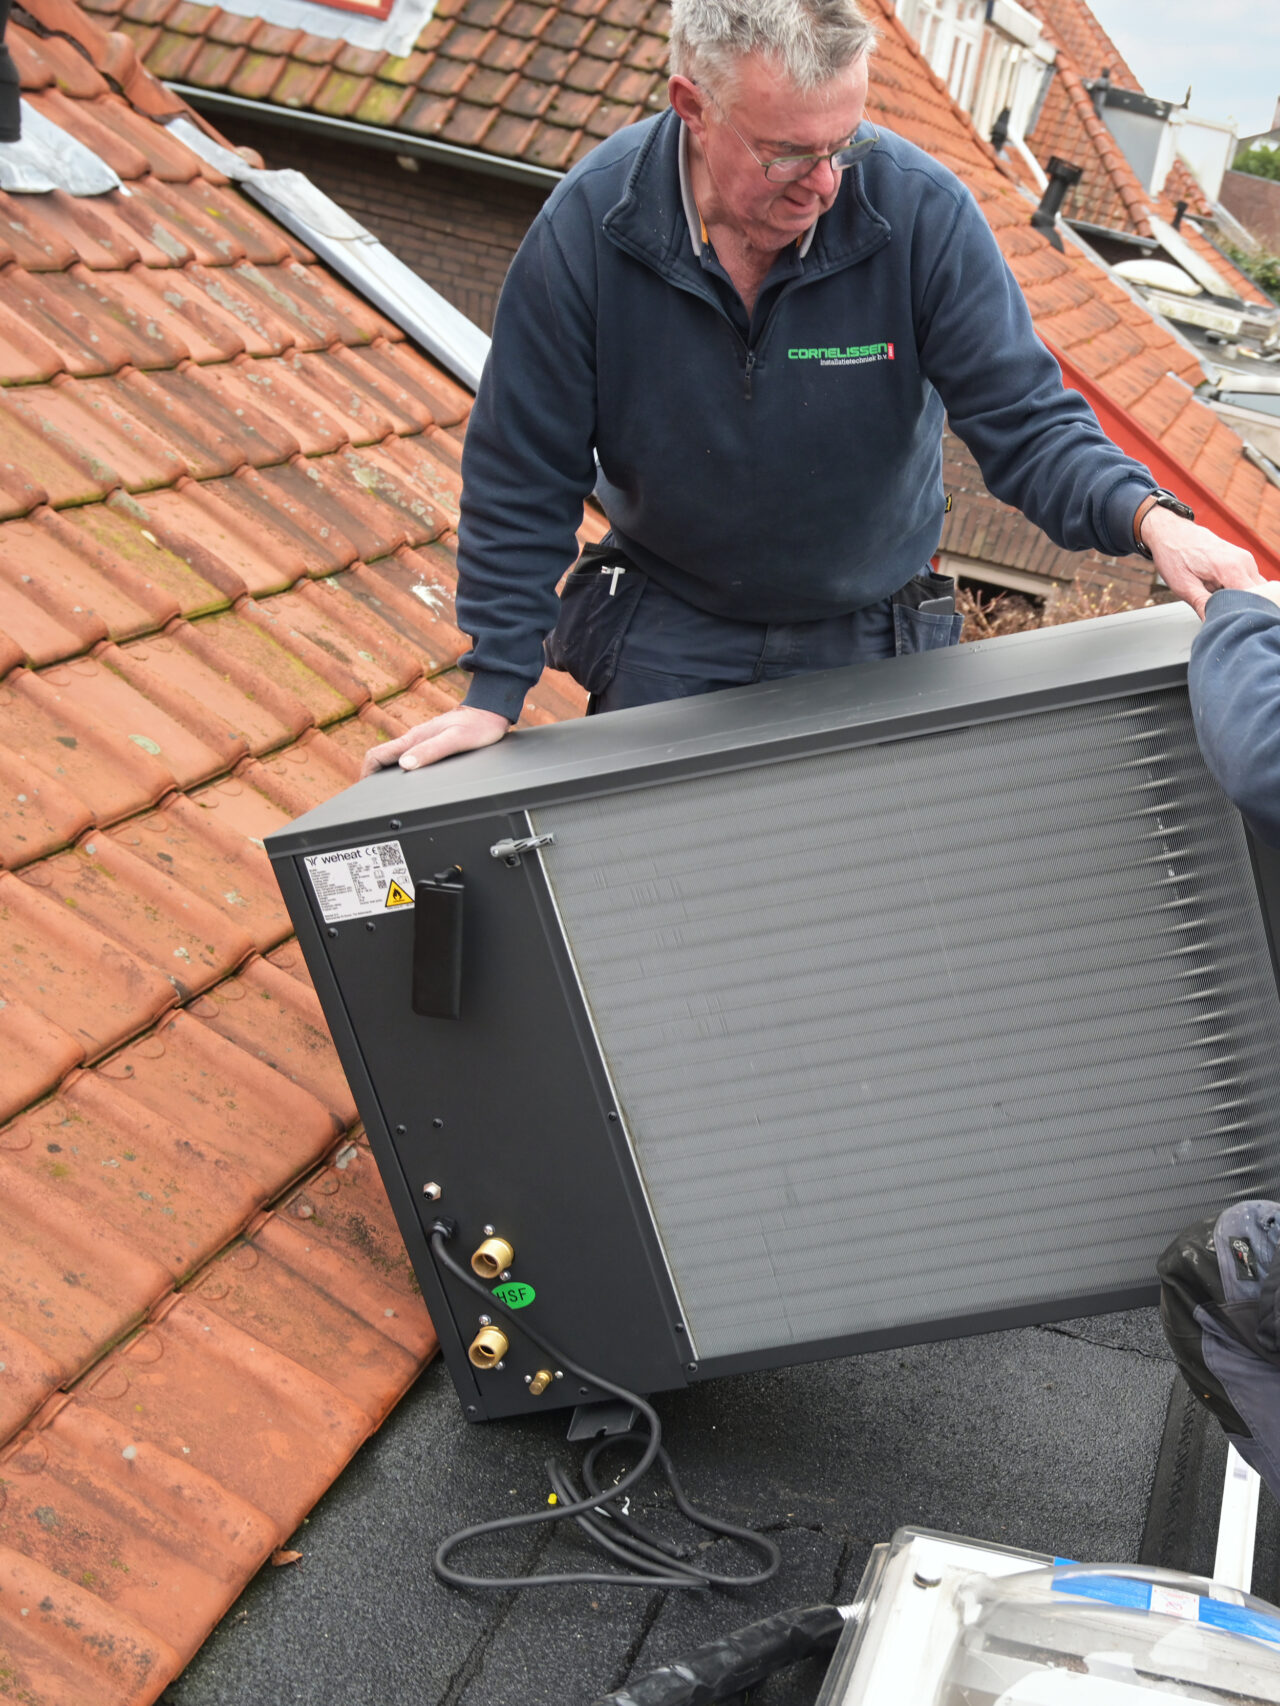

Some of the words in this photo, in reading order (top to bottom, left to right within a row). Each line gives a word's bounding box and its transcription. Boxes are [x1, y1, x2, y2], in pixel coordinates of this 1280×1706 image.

[788, 342, 888, 359] CORNELISSEN
[321, 849, 362, 864] weheat
[496, 1287, 527, 1303] HSF
